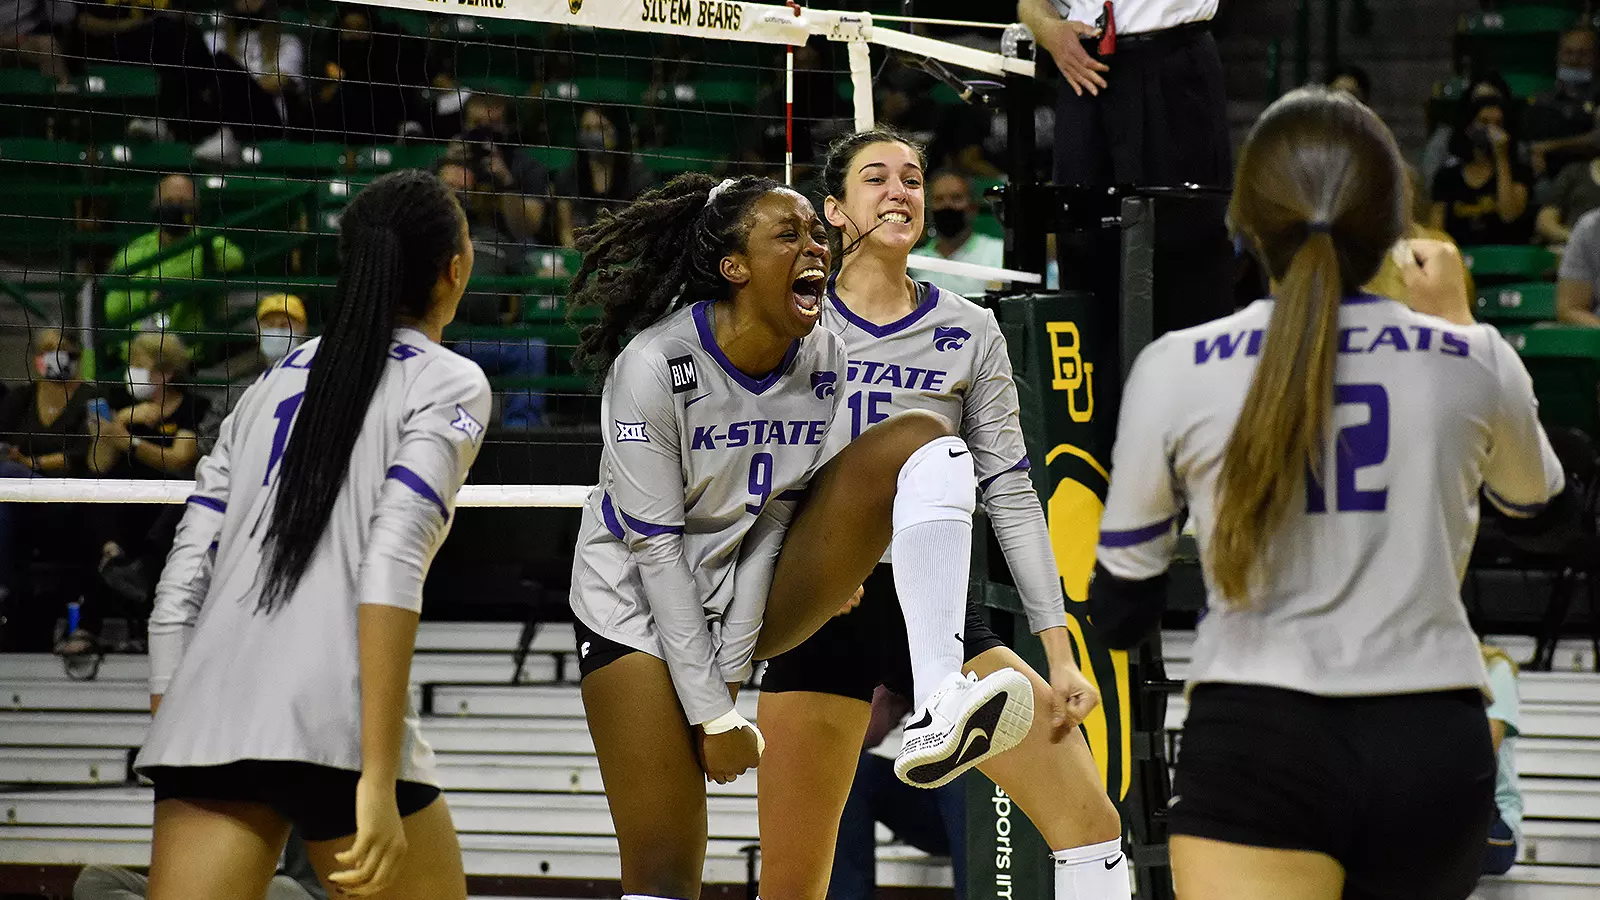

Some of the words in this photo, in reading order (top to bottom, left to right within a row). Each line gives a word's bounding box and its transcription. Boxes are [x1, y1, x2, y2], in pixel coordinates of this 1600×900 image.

[642, 0, 691, 26] SICEM
[697, 1, 743, 31] BEARS
[1194, 326, 1470, 365] WICATS
[671, 361, 697, 387] BLM
[1046, 321, 1094, 423] BU
[691, 420, 826, 450] K-STATE
[848, 390, 892, 443] 15
[746, 452, 774, 516] 9
